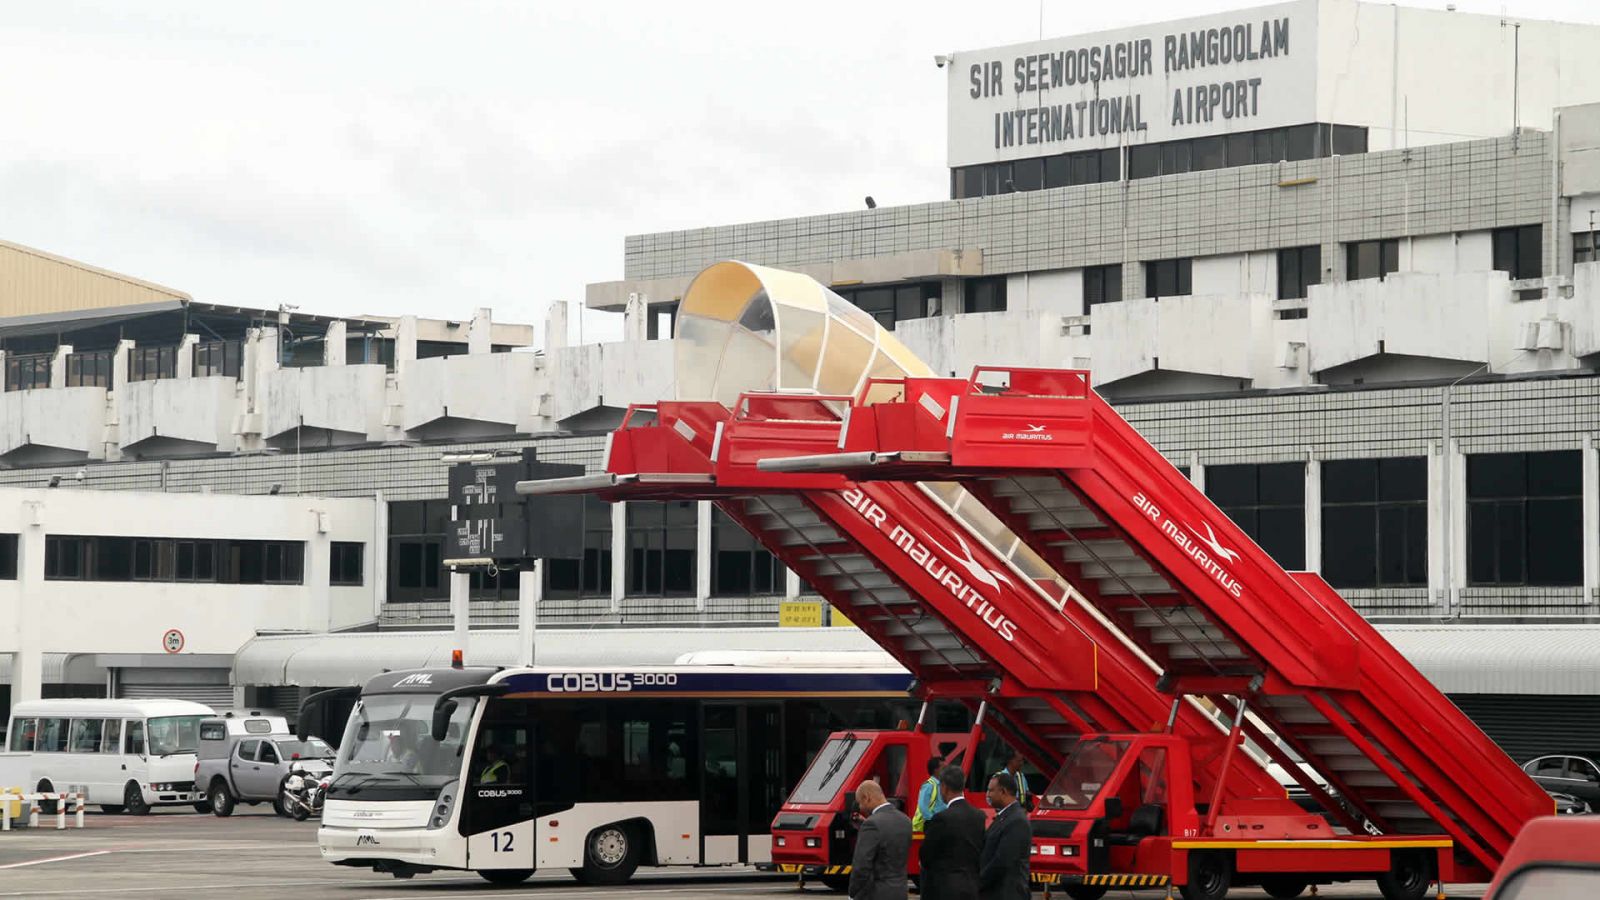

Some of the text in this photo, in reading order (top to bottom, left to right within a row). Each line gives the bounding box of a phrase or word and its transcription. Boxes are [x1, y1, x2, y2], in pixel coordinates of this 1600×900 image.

[970, 17, 1289, 99] SIR SEEWOOSAGUR RAMGOOLAM
[994, 77, 1262, 149] INTERNATIONAL AIRPORT
[167, 636, 180, 645] 3m
[392, 673, 433, 688] AML
[546, 673, 678, 692] COBUS 3000
[478, 789, 507, 798] COBUS
[491, 831, 514, 852] 12
